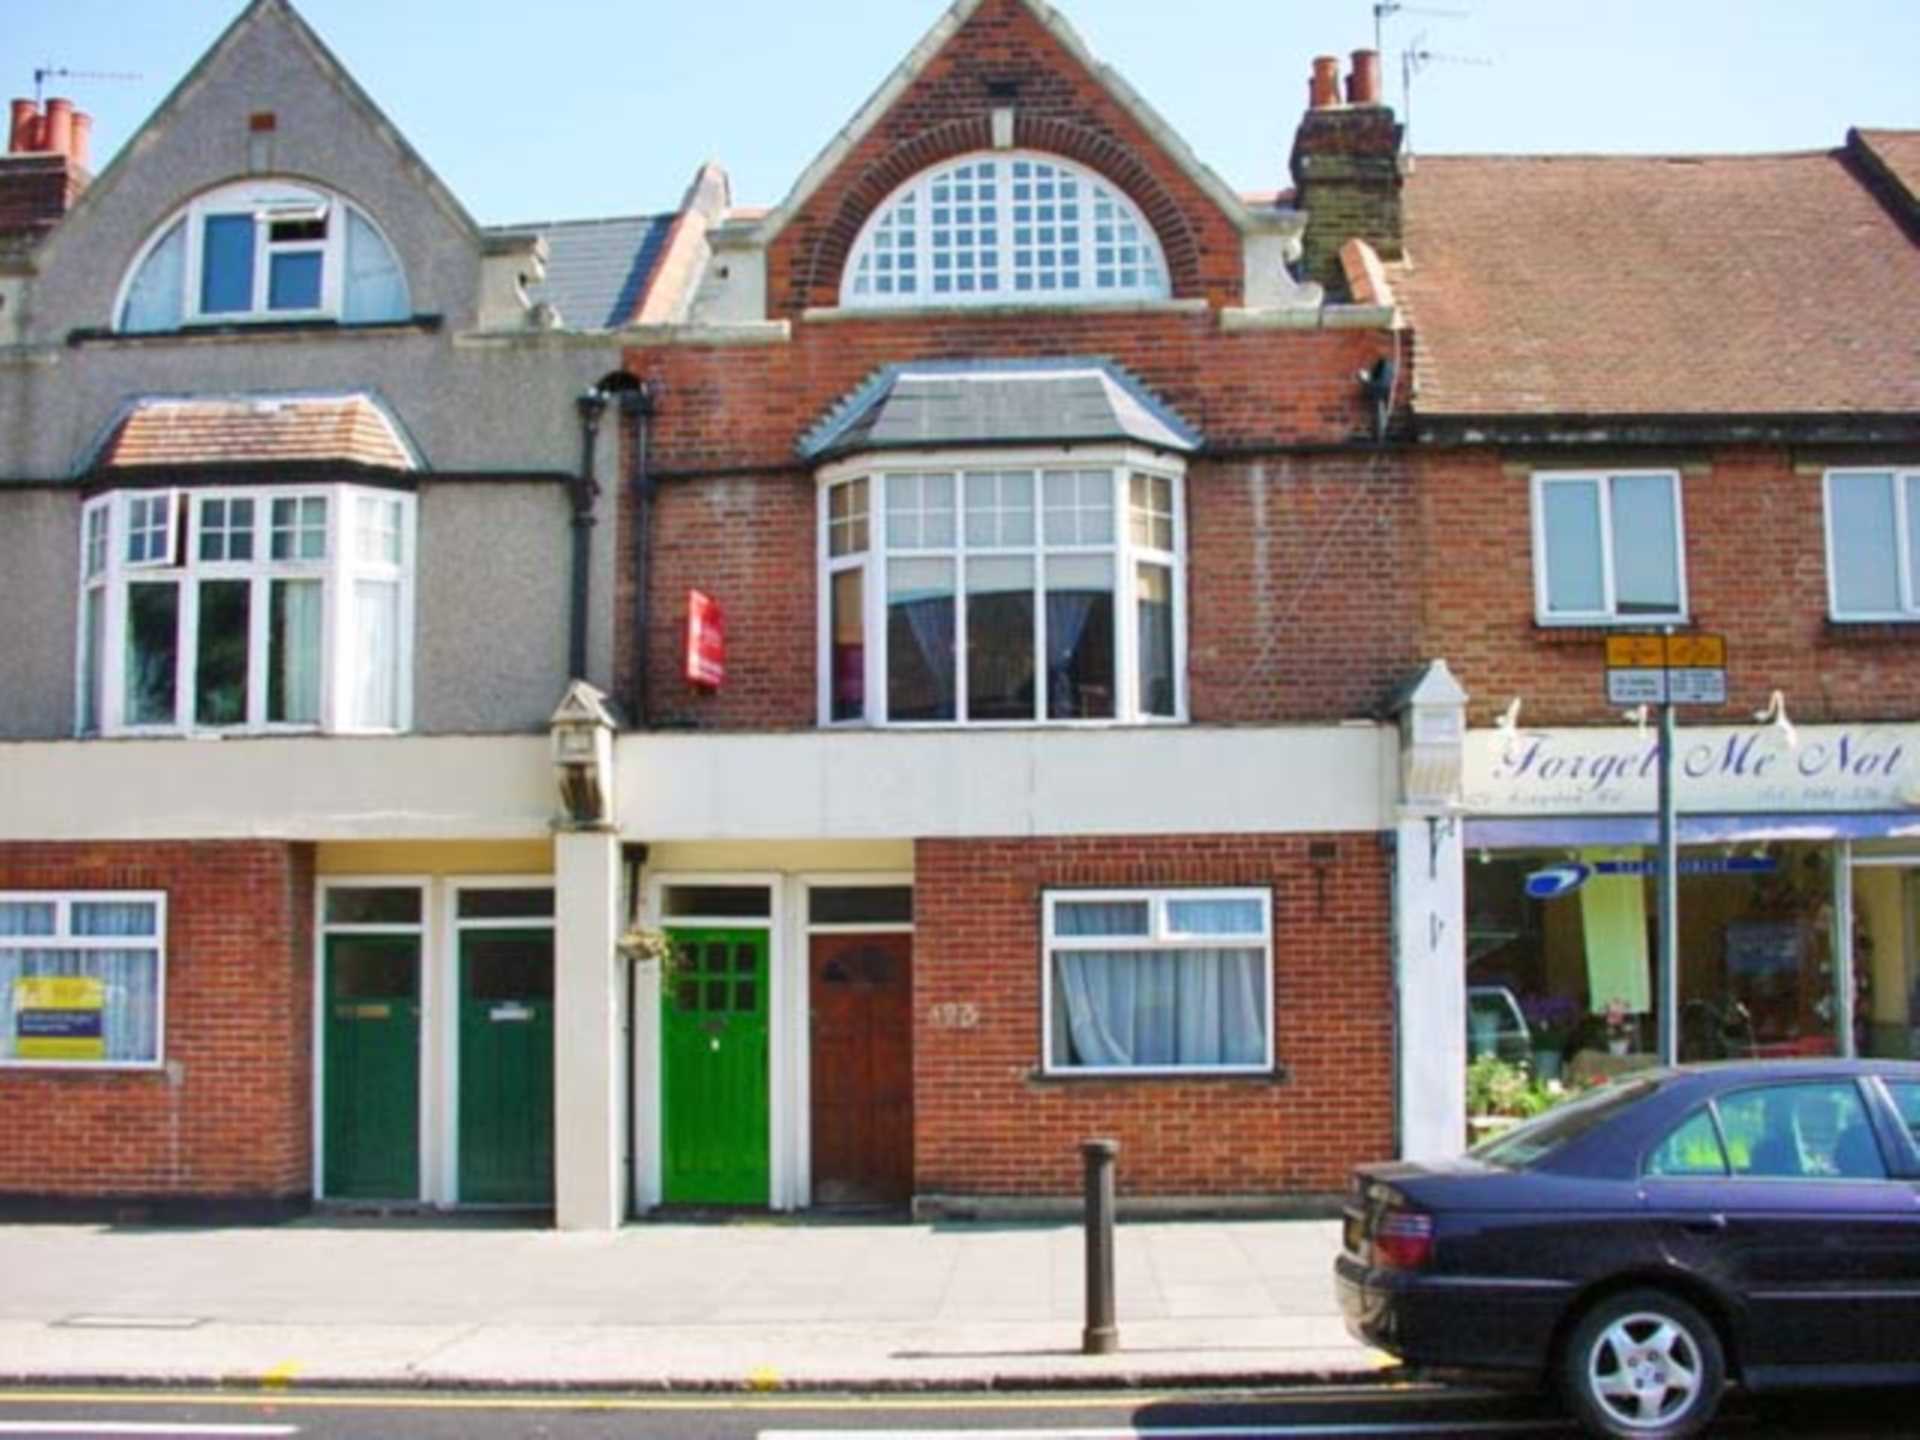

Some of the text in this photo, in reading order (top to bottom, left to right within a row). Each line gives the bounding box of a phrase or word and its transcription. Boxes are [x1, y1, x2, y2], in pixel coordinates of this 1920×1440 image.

[1493, 733, 1902, 790] Forget Me Not
